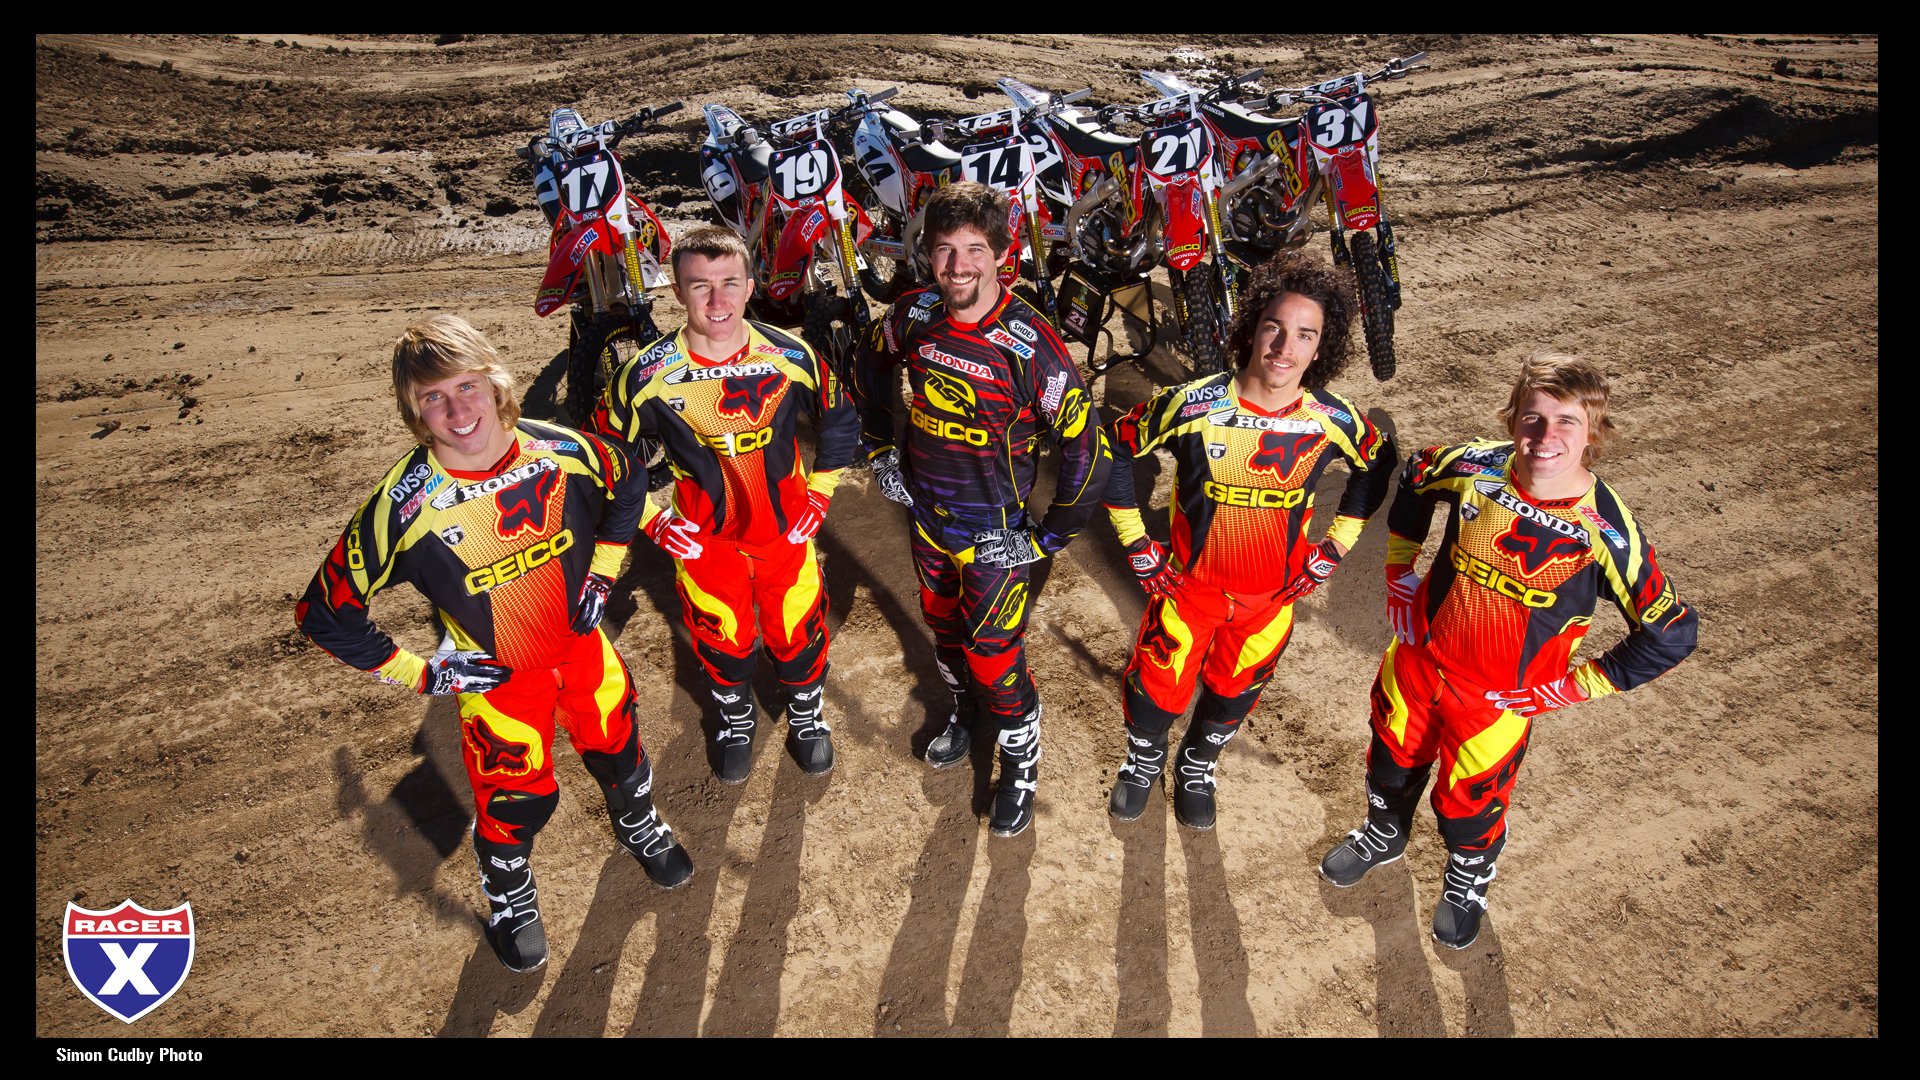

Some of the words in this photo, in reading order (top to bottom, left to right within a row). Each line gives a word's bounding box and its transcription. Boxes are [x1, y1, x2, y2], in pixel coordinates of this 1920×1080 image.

[1049, 113, 1070, 130] HONDA
[1201, 103, 1224, 118] HONDA
[1316, 101, 1368, 148] 31
[1151, 127, 1201, 175] 21
[1267, 130, 1302, 196] GEICO
[776, 150, 828, 200] 19
[969, 146, 1022, 189] 14
[561, 160, 609, 213] 17
[1109, 150, 1137, 225] GEICO
[1345, 206, 1377, 219] GEICO
[1350, 213, 1375, 222] HONDA
[570, 227, 600, 266] AMSOIL
[1168, 244, 1200, 256] GEICO
[1173, 251, 1197, 260] HONDA
[908, 306, 925, 320] DVS
[989, 330, 1034, 358] AMSOIL
[1012, 322, 1035, 340] SHOEI
[639, 345, 665, 365] DVS
[754, 344, 804, 360] AMSOIL
[932, 351, 994, 379] HONDA
[638, 352, 683, 382] AMSOIL
[689, 362, 780, 381] HONDA
[1041, 376, 1057, 412] planet
[1050, 371, 1068, 411] fitness
[1186, 386, 1214, 404] DVS
[1180, 399, 1232, 417] AMSOIL
[1305, 400, 1353, 424] AMSOIL
[911, 407, 989, 446] GEICO
[1235, 414, 1325, 433] HONDA
[523, 440, 579, 452] AMSOIL
[1463, 446, 1494, 464] DVS
[460, 456, 560, 501] HONDA
[1453, 460, 1505, 477] AMSOIL
[388, 473, 421, 502] DVS
[399, 472, 444, 524] AMSOIL
[1203, 480, 1306, 509] GEICO
[1496, 492, 1592, 548] HONDA
[1580, 505, 1628, 549] AMSOIL
[464, 528, 575, 596] GEICO
[1451, 542, 1558, 609] GEICO
